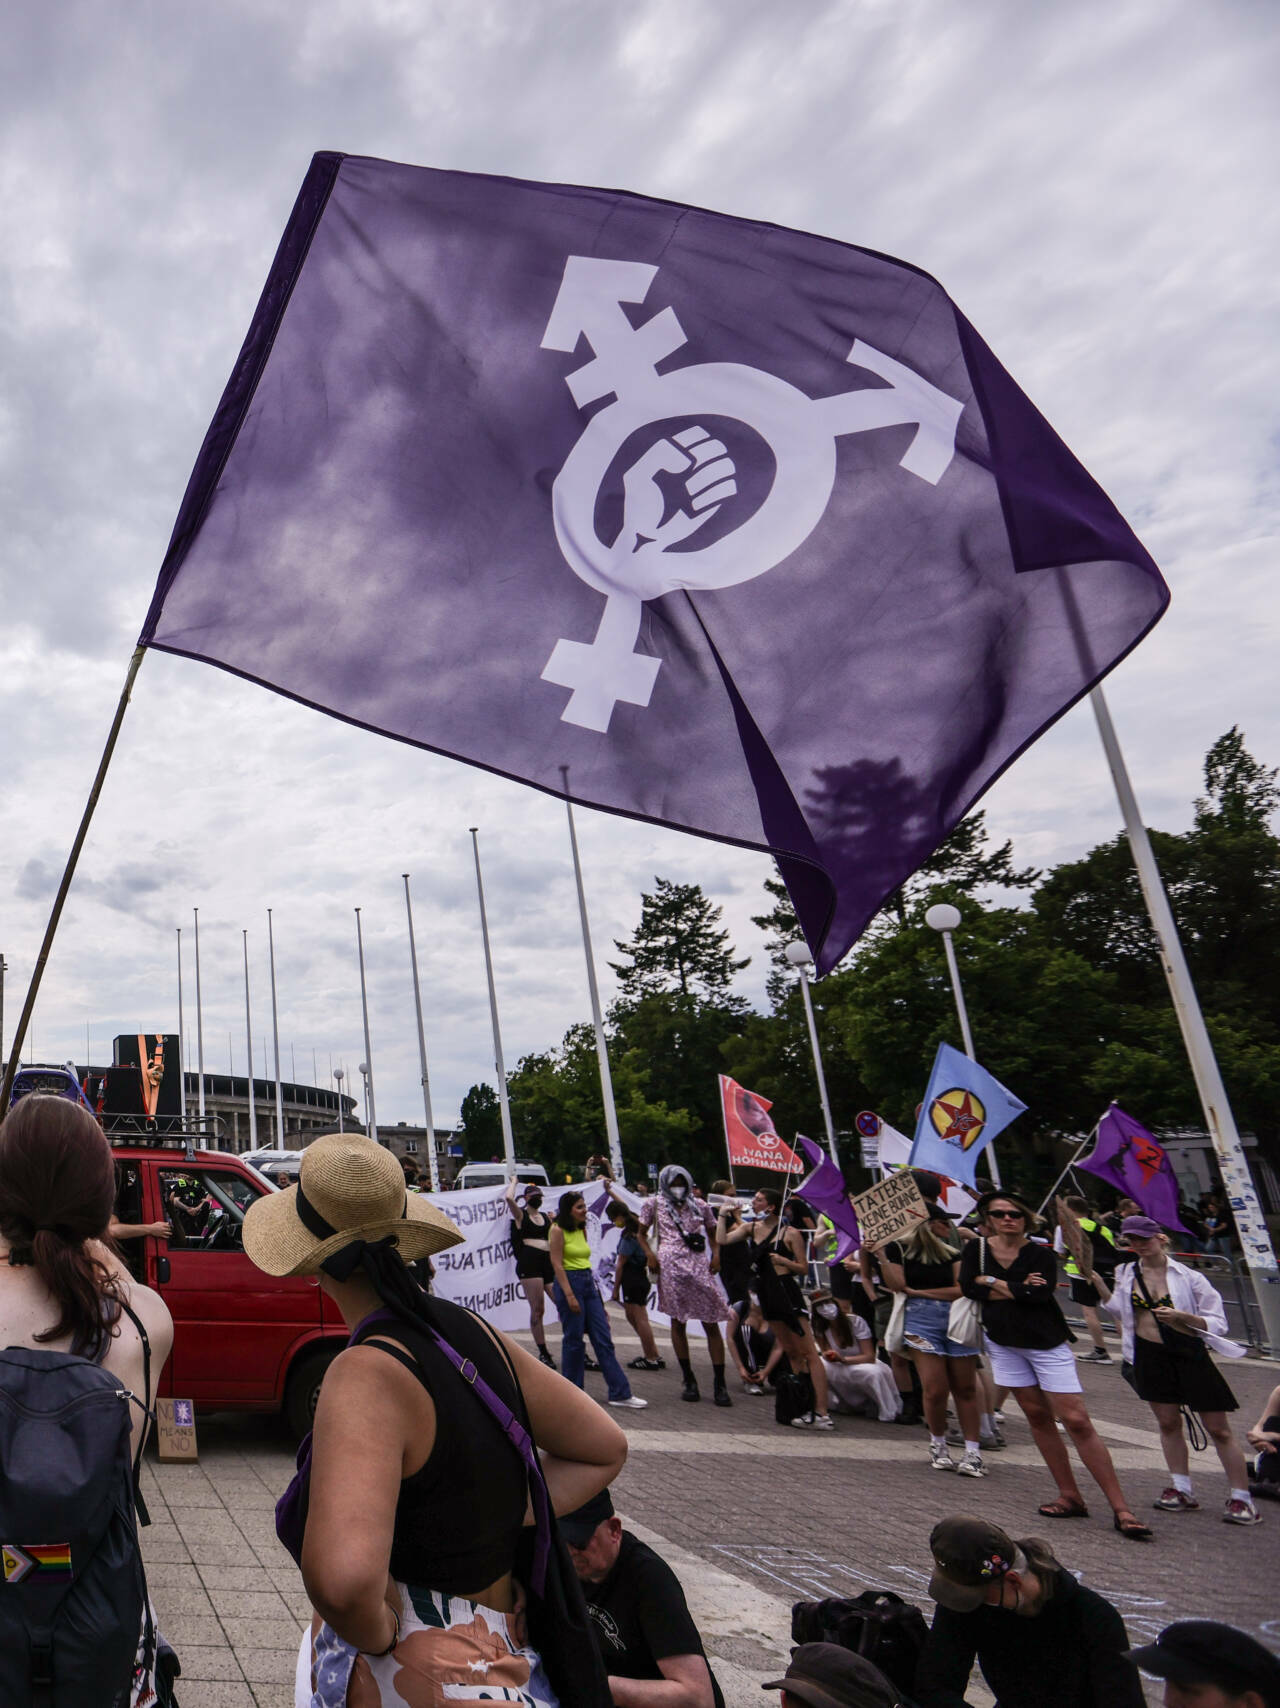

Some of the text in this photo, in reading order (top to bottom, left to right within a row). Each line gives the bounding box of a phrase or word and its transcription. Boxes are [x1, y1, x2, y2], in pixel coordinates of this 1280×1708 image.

[743, 1146, 784, 1161] IVANA
[158, 1403, 174, 1420] NO
[160, 1427, 193, 1437] MEANS
[171, 1438, 190, 1452] NO
